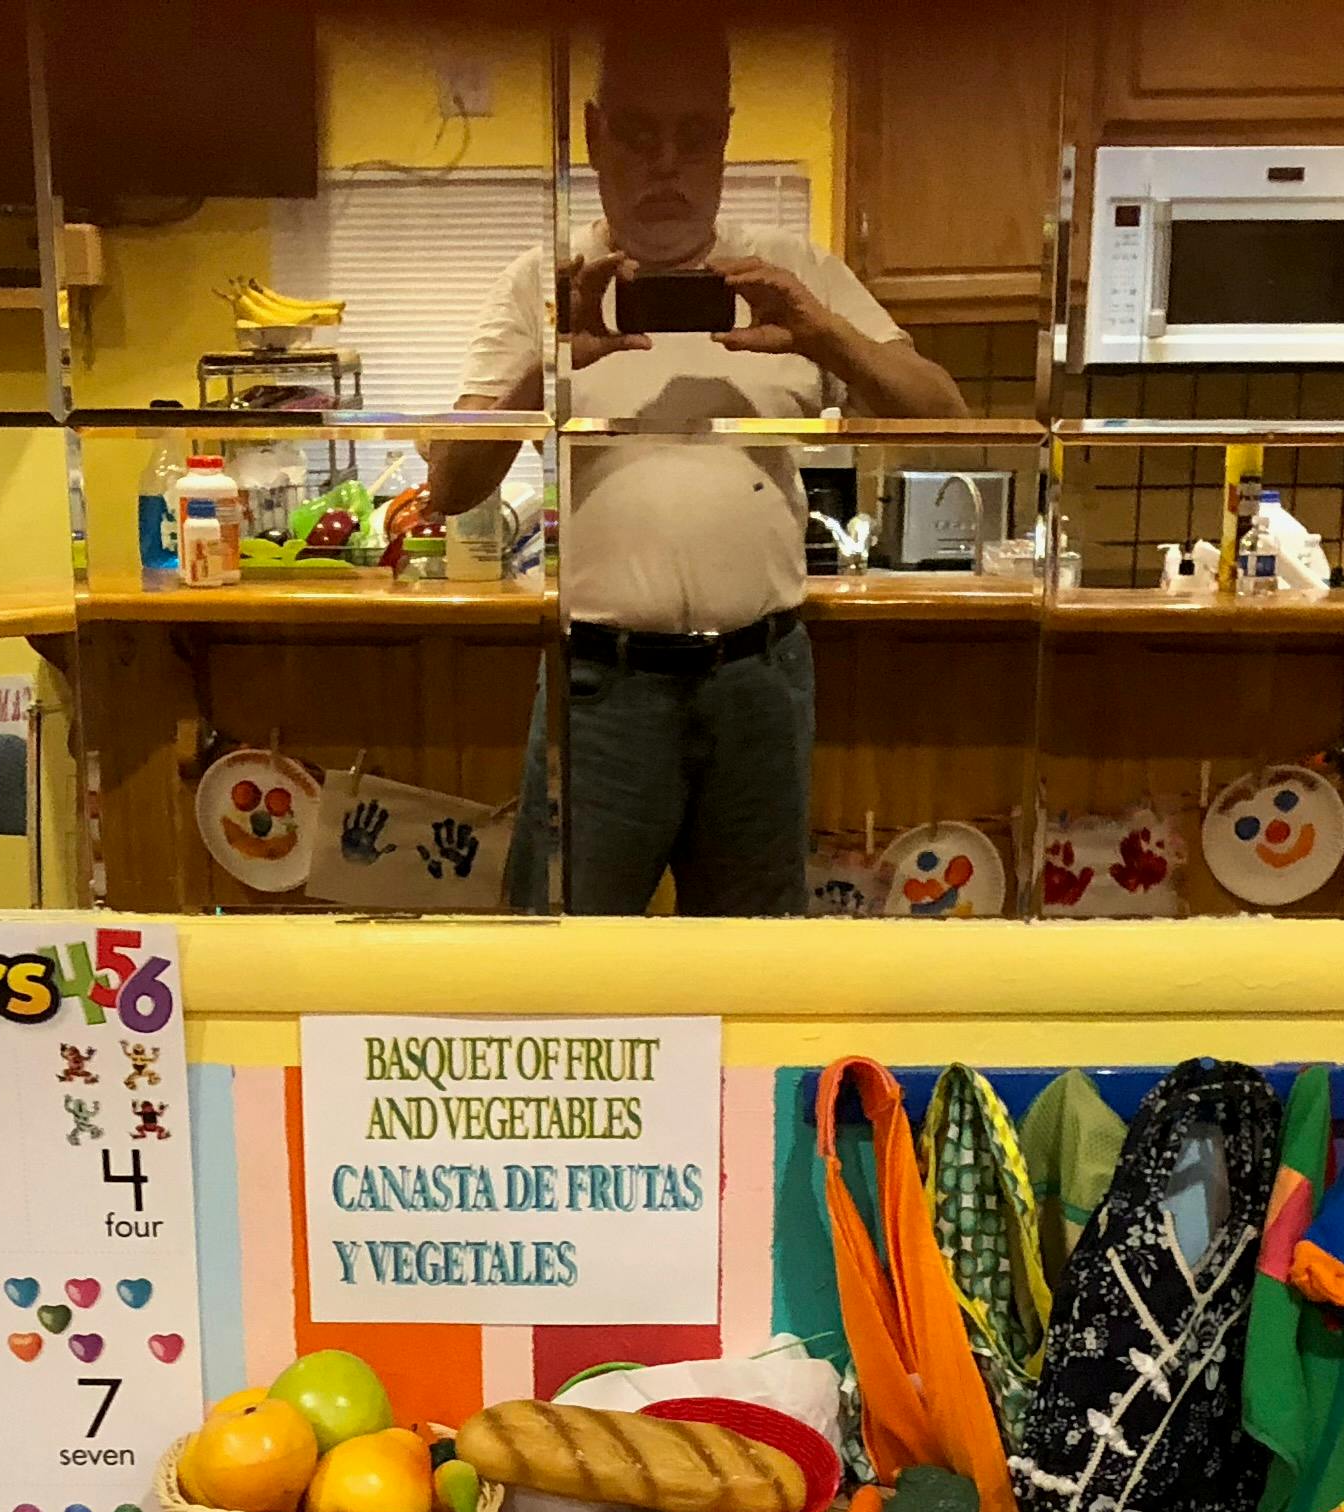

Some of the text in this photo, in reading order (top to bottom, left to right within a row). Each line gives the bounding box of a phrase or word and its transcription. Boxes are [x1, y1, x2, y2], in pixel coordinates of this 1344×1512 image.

[364, 1036, 659, 1091] BASQUET OF FRUIT
[365, 1096, 643, 1140] AND VEGETABLES
[102, 1149, 148, 1211] 4
[332, 1163, 704, 1213] CANASTA DE FRUTAS
[104, 1213, 164, 1238] four
[333, 1240, 579, 1286] Y VEGETALES
[77, 1379, 122, 1438] 7
[58, 1445, 136, 1467] seven
